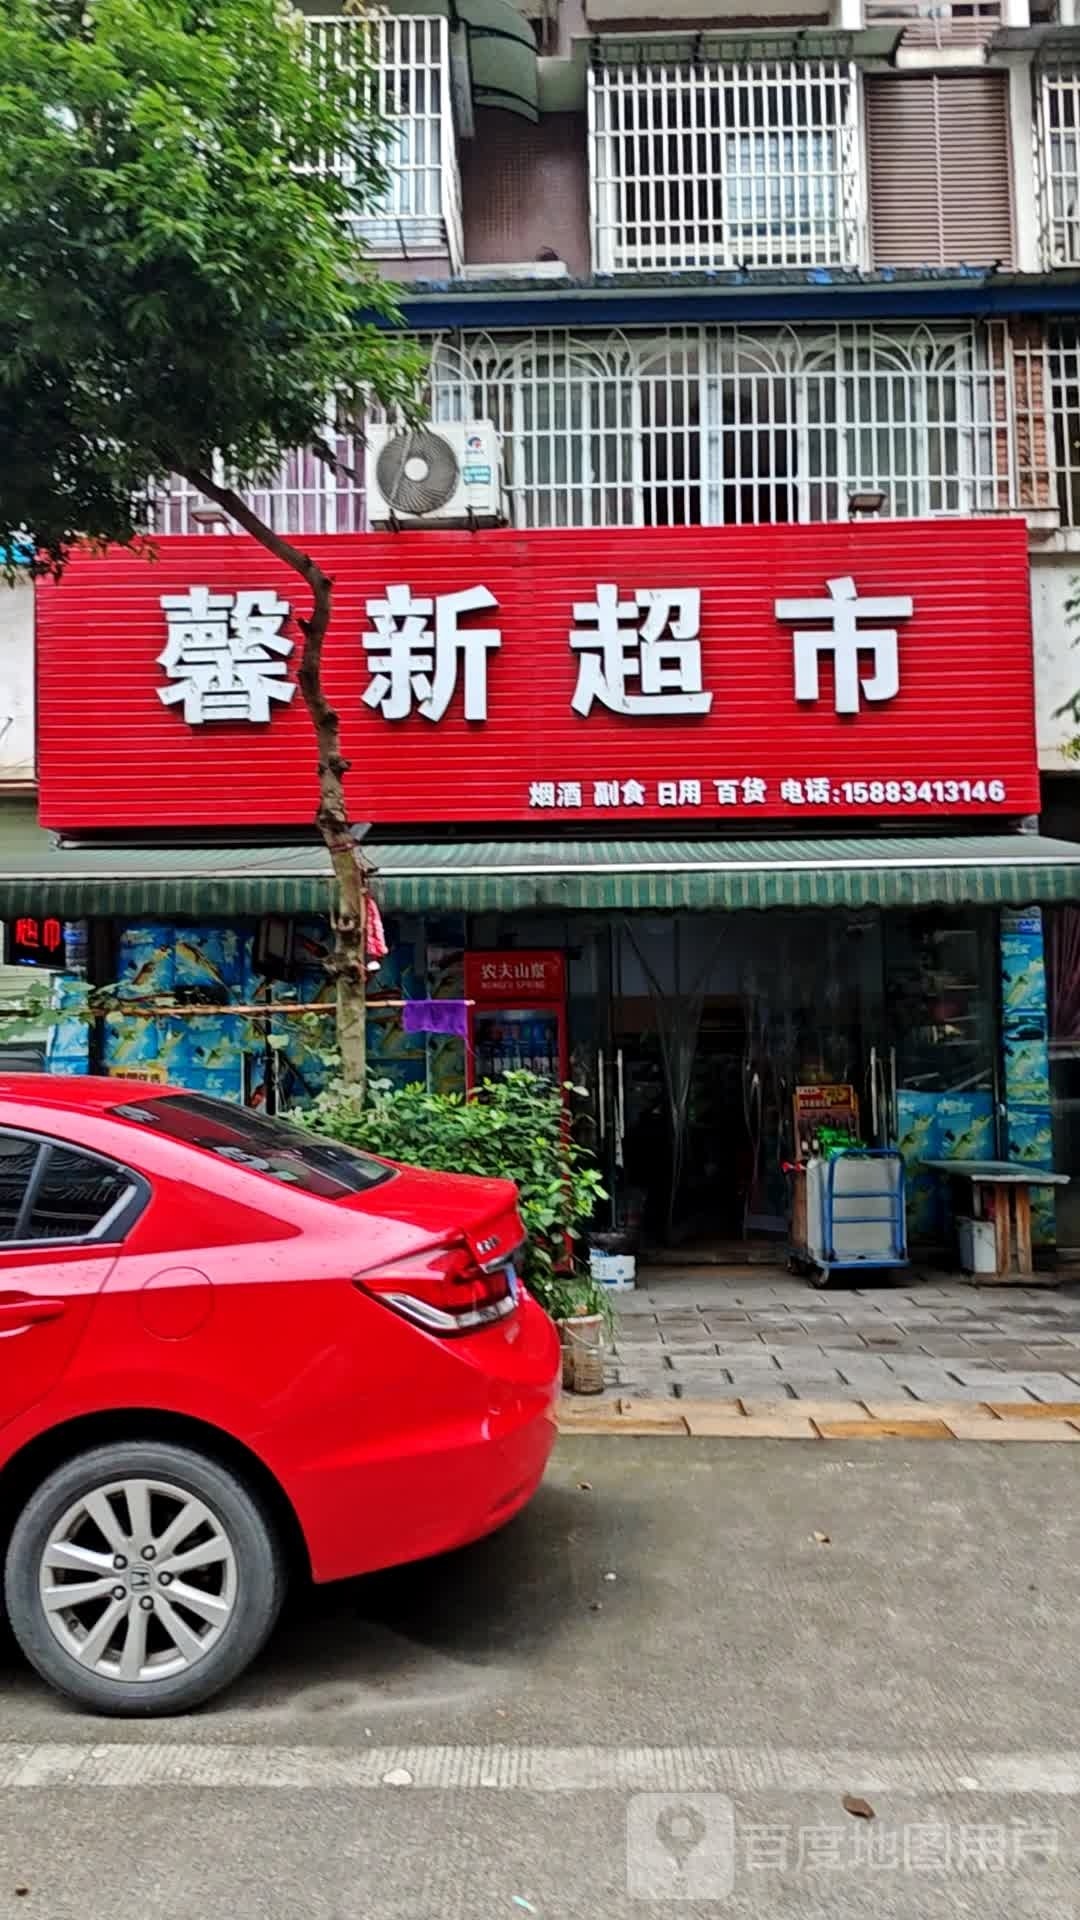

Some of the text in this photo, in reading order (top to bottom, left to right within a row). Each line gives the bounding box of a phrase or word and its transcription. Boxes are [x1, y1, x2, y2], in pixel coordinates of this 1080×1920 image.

[155, 576, 914, 724] 馨新超市
[528, 781, 582, 807] 烟酒
[593, 779, 646, 806] 副食
[657, 779, 701, 806] 日用
[712, 776, 767, 805] 百货
